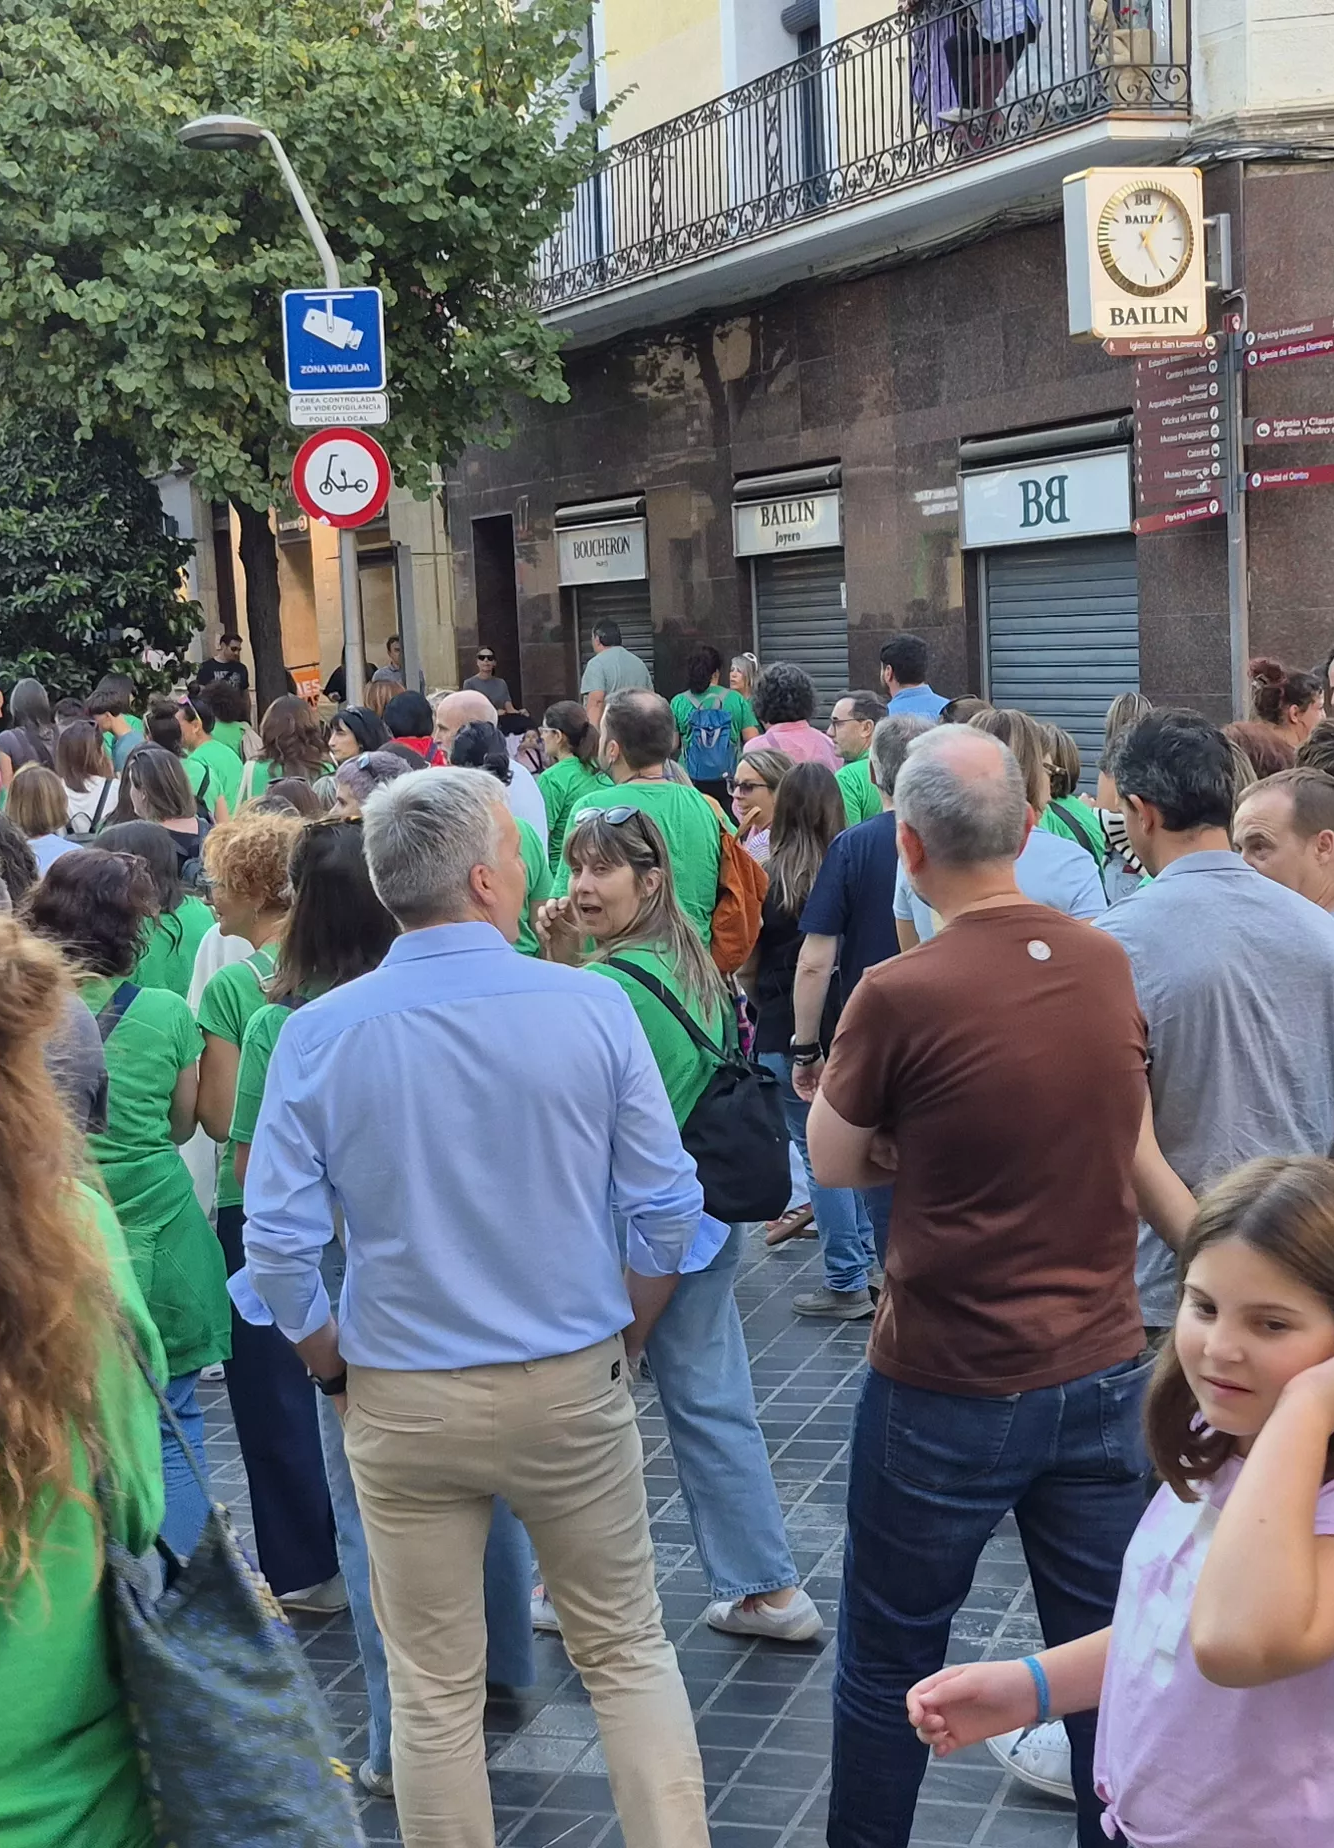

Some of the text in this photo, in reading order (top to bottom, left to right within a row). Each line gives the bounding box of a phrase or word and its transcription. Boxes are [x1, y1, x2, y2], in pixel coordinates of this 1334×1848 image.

[1109, 305, 1189, 327] BAILIN
[1129, 339, 1203, 352] Iglesia de San Lorenzo
[1259, 350, 1279, 362] Iglesia
[1279, 348, 1287, 356] de
[300, 363, 371, 374] ZONA VIGILADA
[323, 396, 377, 404] CONTROLADA
[314, 404, 381, 412] VIDEOVIGILANCIA
[1273, 420, 1301, 430] Iglesia
[1273, 429, 1285, 438] de
[1286, 428, 1303, 437] San
[1304, 426, 1331, 436] Pedro
[760, 500, 815, 528] BAILIN
[775, 530, 801, 547] Joyero
[573, 536, 631, 560] BOUCHERON
